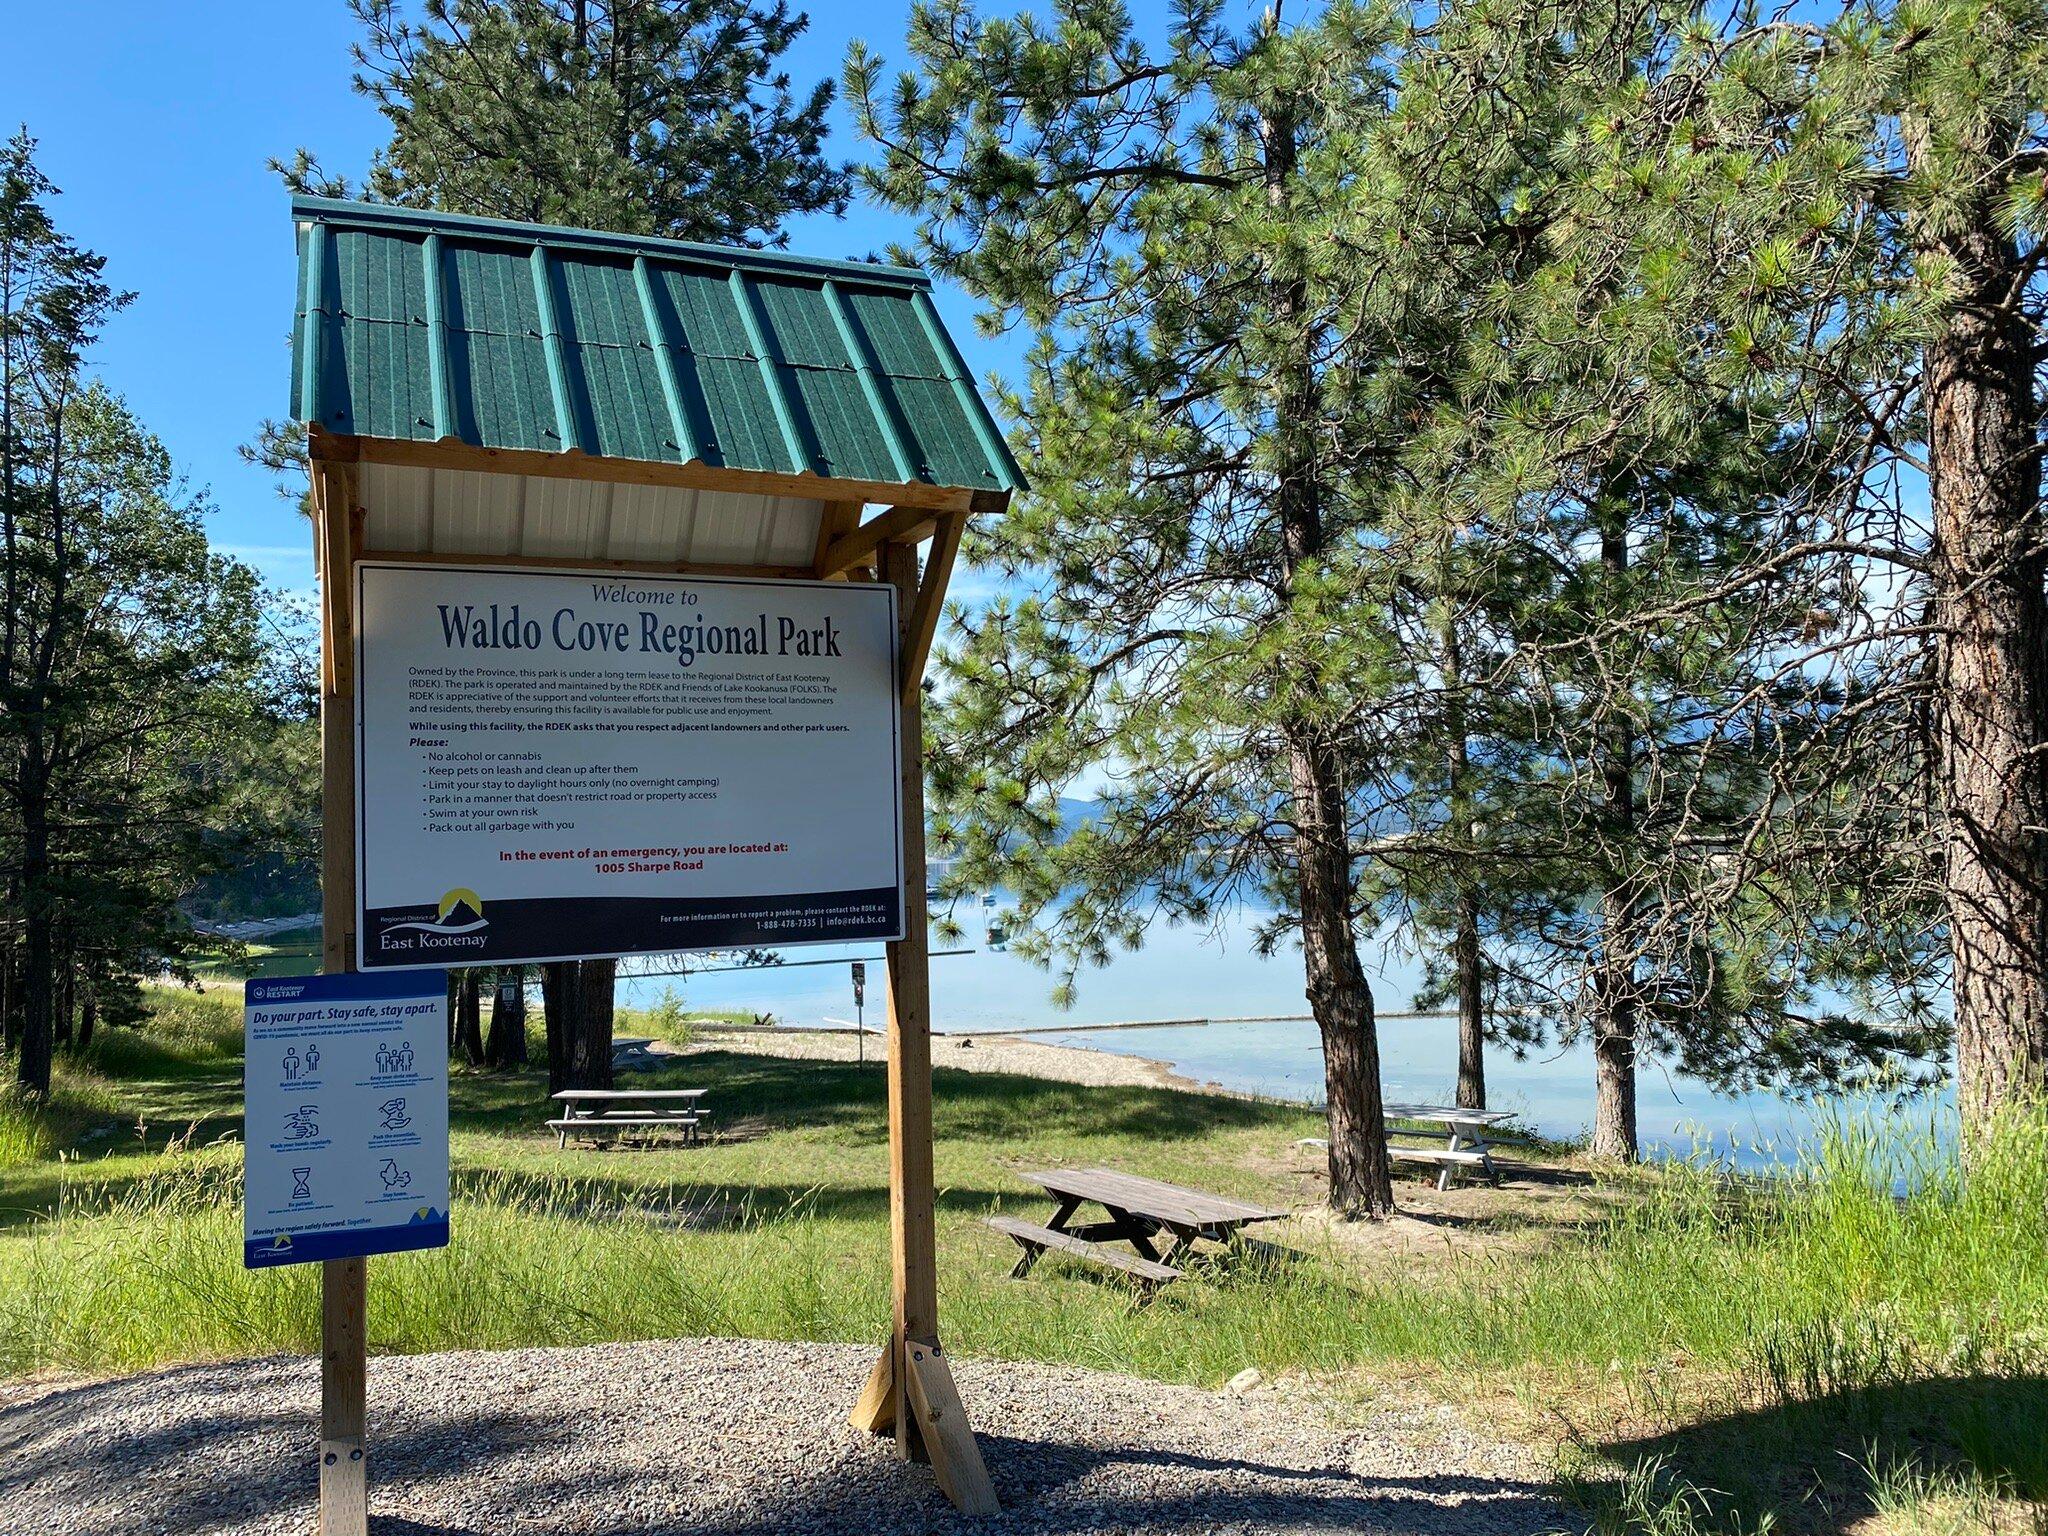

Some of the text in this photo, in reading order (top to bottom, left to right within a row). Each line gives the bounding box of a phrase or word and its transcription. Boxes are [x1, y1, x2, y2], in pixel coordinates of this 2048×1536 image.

[593, 584, 698, 605] Welcome to
[437, 604, 842, 667] Waldo Cove Regional Park
[409, 667, 443, 676] Owned
[444, 667, 458, 679] by
[458, 667, 476, 677] the
[476, 668, 518, 678] Province,
[519, 668, 536, 677] this
[538, 668, 558, 680] park
[559, 668, 567, 678] is
[568, 669, 596, 678] under
[604, 669, 624, 681] long
[626, 671, 646, 679] term
[648, 670, 670, 680] lease
[671, 672, 681, 680] to
[682, 671, 696, 680] the
[698, 671, 734, 683] Regional
[735, 672, 764, 681] District
[765, 672, 774, 681] of
[775, 673, 792, 682] East
[793, 673, 830, 685] Kootenay
[409, 704, 427, 713] and
[429, 704, 473, 714] residents,
[475, 704, 511, 716] thereby
[513, 704, 553, 716] ensuring
[554, 704, 571, 714] this
[573, 704, 602, 716] facility
[603, 705, 610, 714] is
[612, 705, 650, 714] available
[652, 705, 664, 714] for
[666, 705, 692, 717] public
[710, 706, 726, 715] and
[727, 706, 773, 717] enjoyment.
[409, 722, 438, 731] While
[439, 722, 467, 734] using
[469, 722, 487, 731] this
[489, 722, 526, 734] facility,
[527, 722, 543, 731] the
[545, 723, 571, 731] RDEK
[572, 722, 593, 731] asks
[595, 722, 615, 731] that
[616, 725, 633, 734] you
[635, 723, 669, 734] respect
[670, 722, 709, 734] adjacent
[710, 722, 761, 731] landowners
[763, 722, 779, 731] and
[781, 722, 803, 731] other
[805, 722, 824, 734] park
[409, 737, 448, 746] Please:
[428, 752, 443, 761] No
[445, 751, 482, 761] alcohol
[497, 751, 541, 761] cannabis
[428, 766, 456, 777] Keep
[456, 767, 478, 777] pets
[496, 765, 522, 774] leash
[524, 765, 543, 774] and
[545, 765, 571, 774] clean
[573, 767, 587, 776] up
[588, 764, 612, 773] after
[613, 764, 638, 773] them
[428, 777, 719, 791] Limit your stay to daylight hours only (no overnight camping)
[428, 794, 452, 803] Park
[453, 794, 463, 803] in
[514, 793, 535, 802] that
[536, 792, 572, 801] doesn't
[574, 792, 607, 801] restrict
[610, 791, 631, 800] road
[645, 792, 686, 803] property
[429, 808, 457, 818] Swim
[459, 809, 469, 817] at
[471, 810, 494, 819] your
[520, 806, 538, 816] risk
[429, 820, 574, 833] Pack out all garbage with you
[499, 842, 787, 861] In the event of an emergency, you are located at:
[594, 859, 703, 874] 1005 Sharpe Road
[380, 915, 406, 923] Regional
[690, 912, 730, 921] information
[748, 911, 768, 920] report
[804, 908, 824, 917] please
[825, 906, 848, 914] contact
[849, 905, 859, 913] the
[861, 904, 876, 912] RDEK
[757, 915, 885, 929] 1-888-478-7335 info@rdek.bc.ca
[381, 932, 488, 949] East Kootenay
[253, 1003, 437, 1025] Do your part. Stay safe, stay apart.
